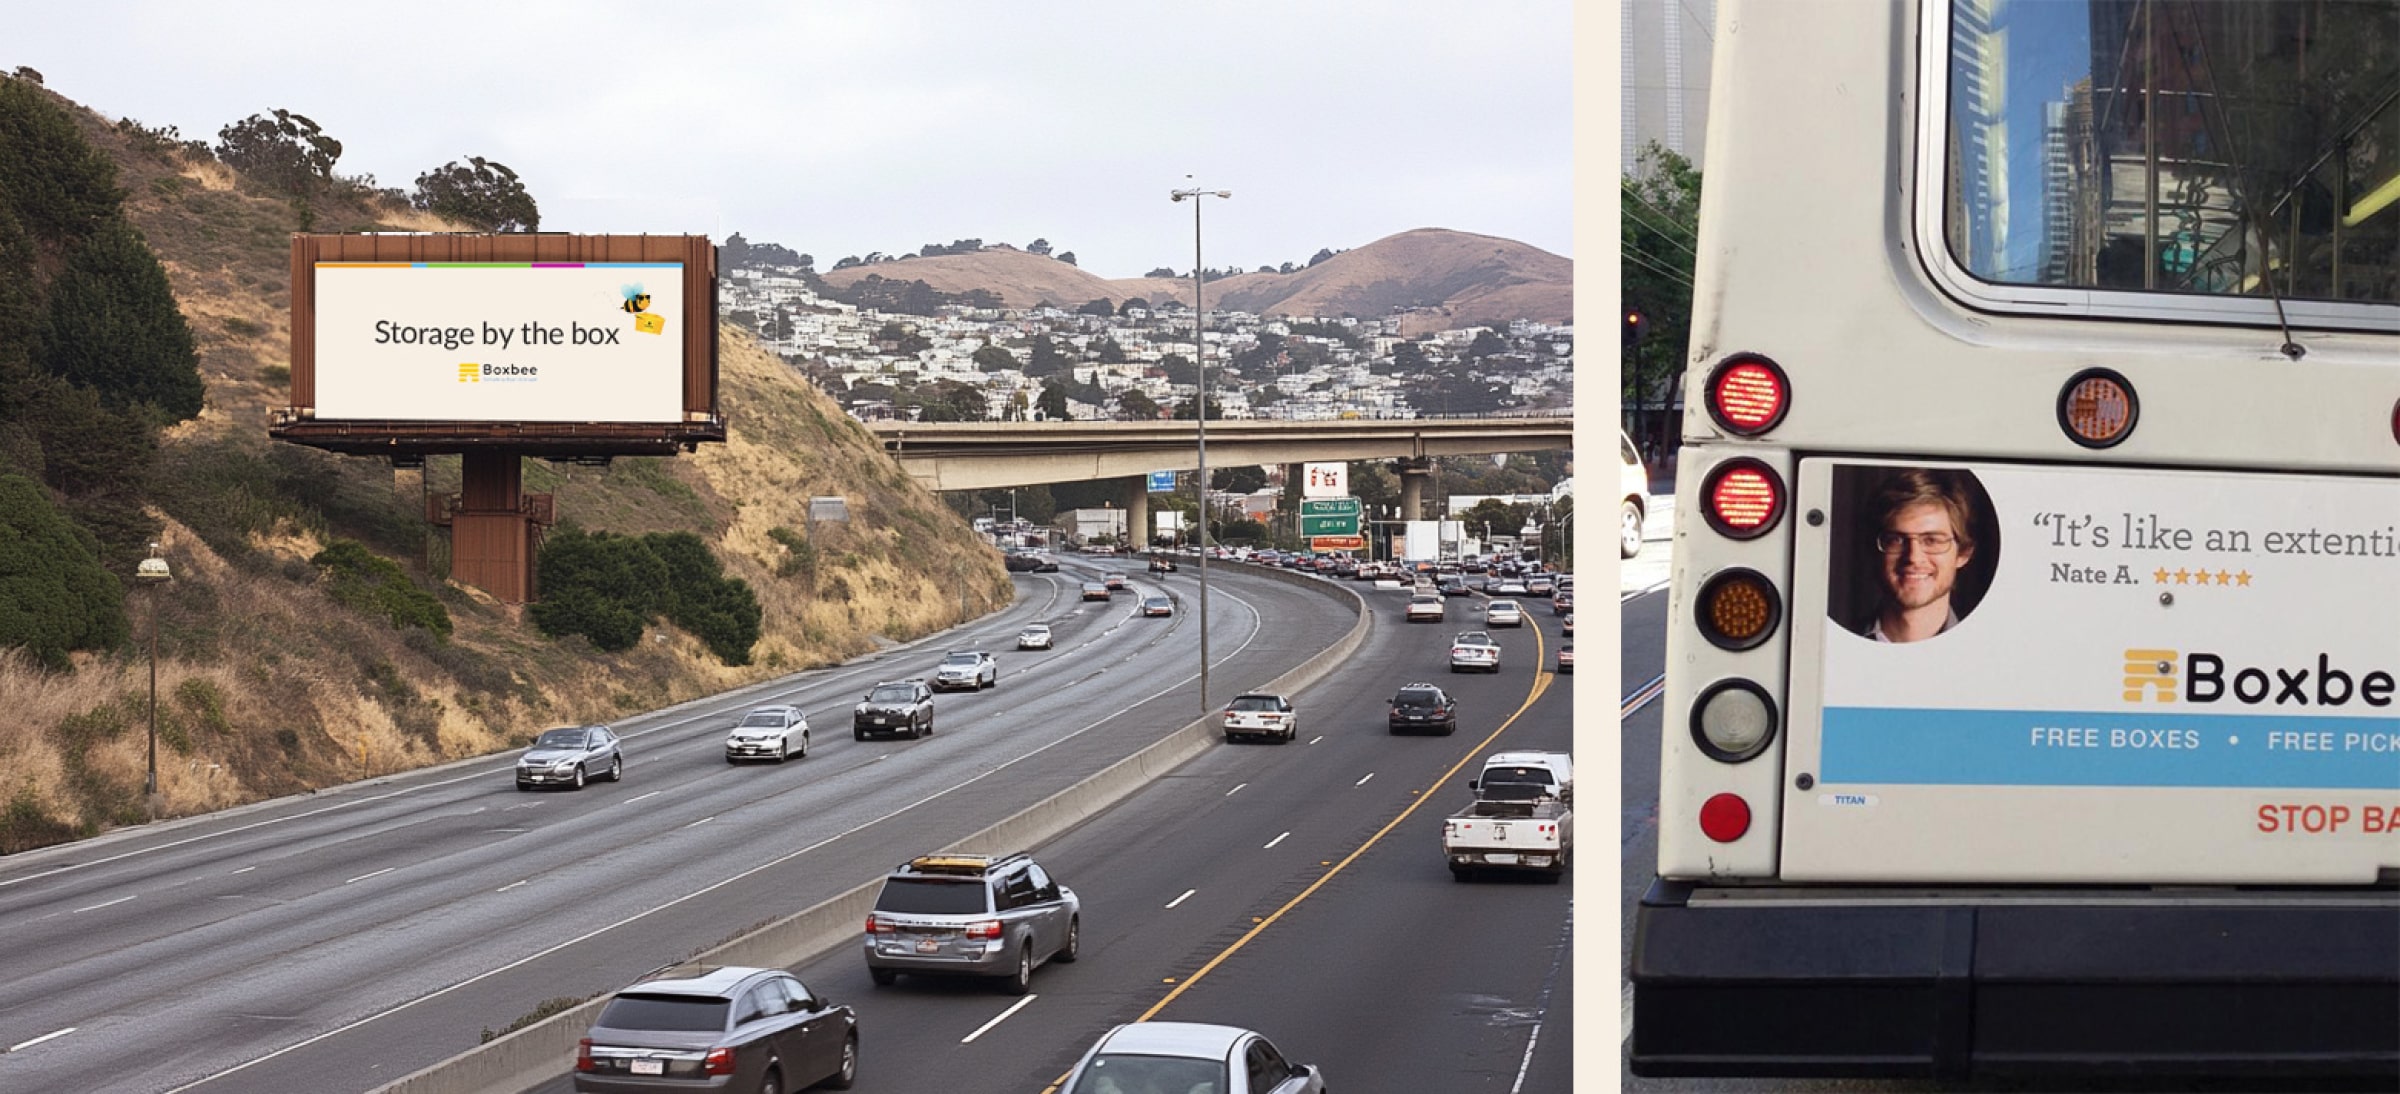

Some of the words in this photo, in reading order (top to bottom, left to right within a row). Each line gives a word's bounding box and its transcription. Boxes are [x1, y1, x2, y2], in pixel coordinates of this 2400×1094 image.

[375, 319, 475, 350] Storage
[482, 320, 515, 350] by
[520, 320, 565, 345] the
[572, 320, 620, 345] box
[483, 363, 538, 375] Boxbee
[2121, 512, 2193, 551] like
[2205, 528, 2251, 552] an
[2263, 526, 2400, 557] extenti
[2050, 562, 2107, 583] Nate
[2112, 564, 2139, 585] A.
[2185, 652, 2396, 707] Boxbe
[2031, 727, 2099, 747] FREE
[2110, 728, 2200, 749] BOXES
[2267, 731, 2334, 750] FREE
[1835, 795, 1866, 805] TITAN
[2257, 804, 2351, 833] STOP
